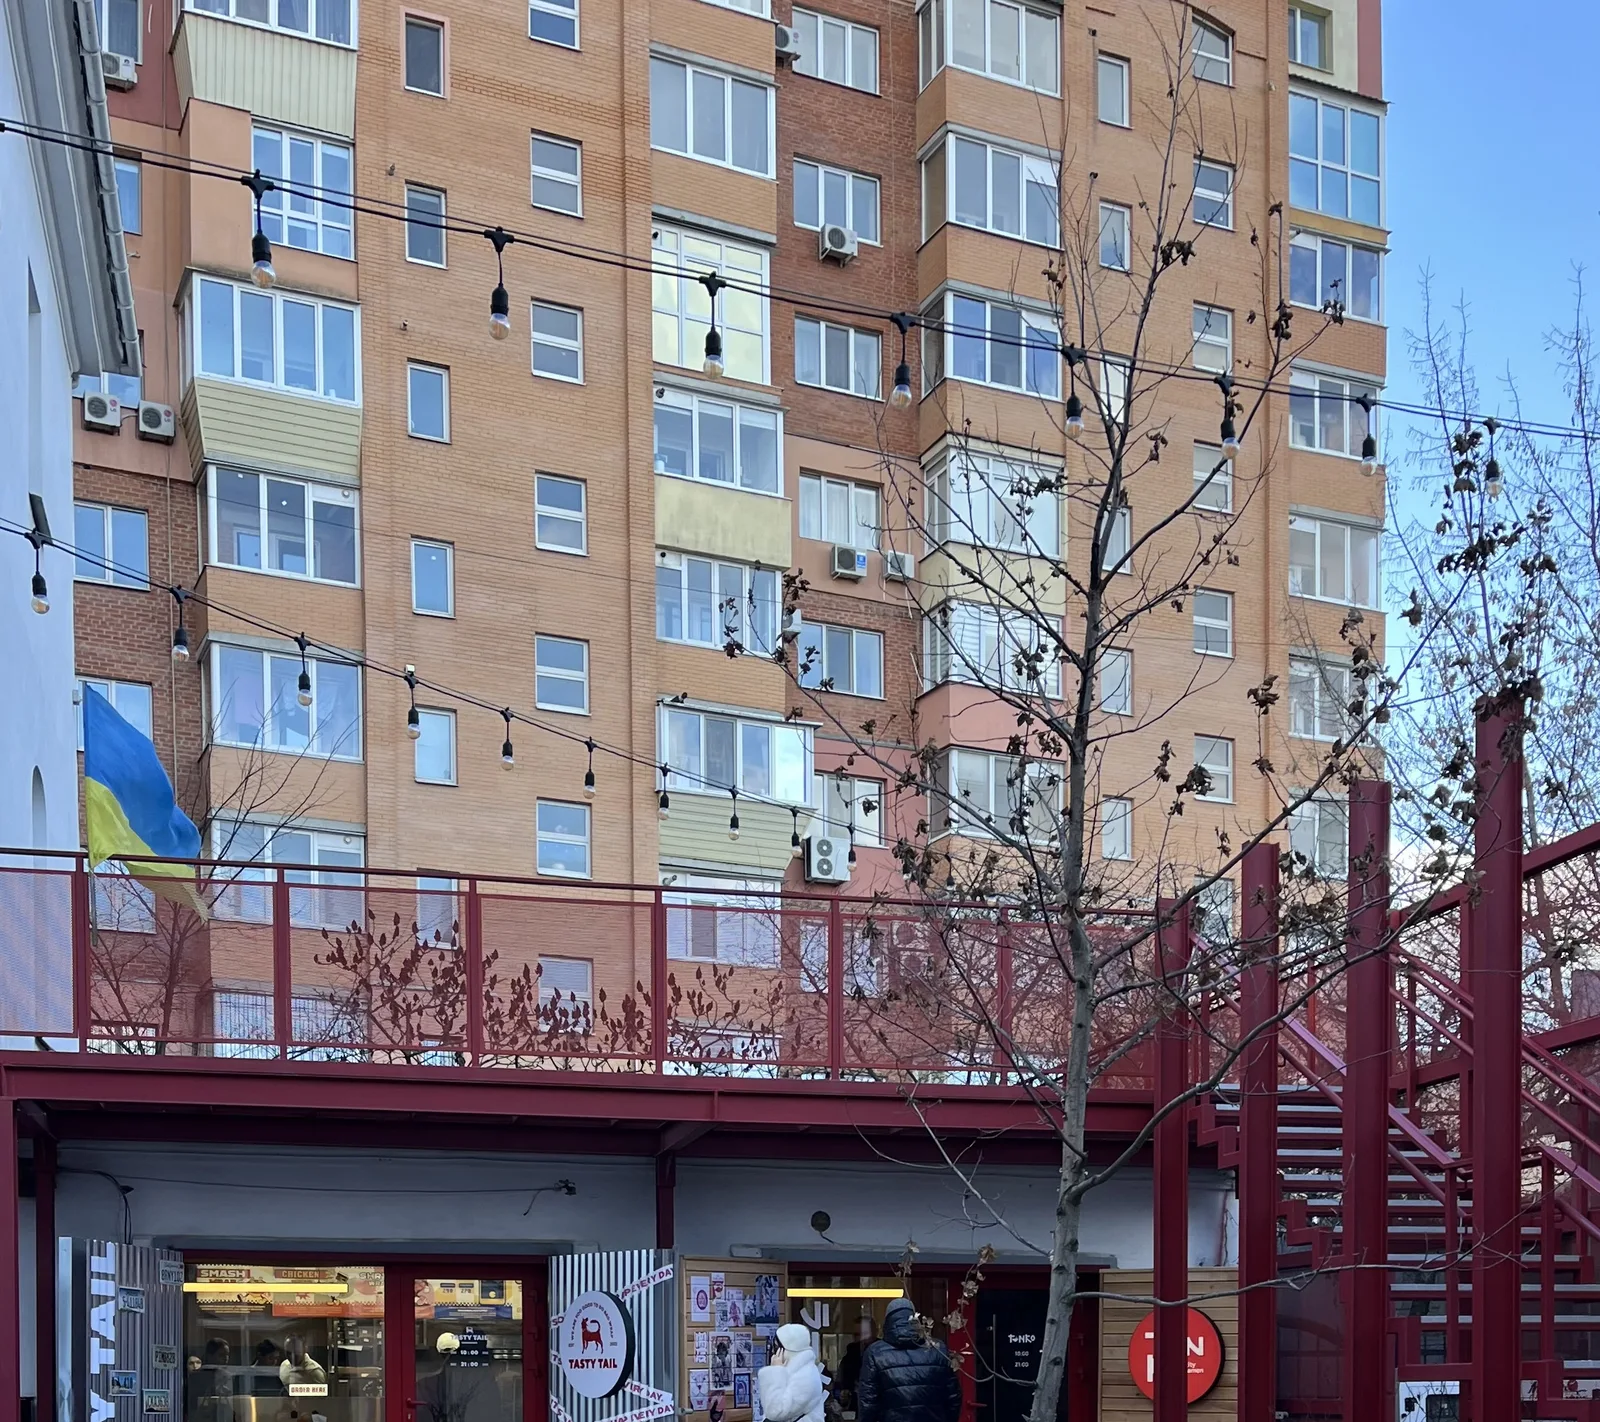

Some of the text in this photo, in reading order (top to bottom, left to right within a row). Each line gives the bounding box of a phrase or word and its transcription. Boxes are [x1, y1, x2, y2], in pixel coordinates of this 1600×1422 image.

[200, 1269, 246, 1278] SMASH
[281, 1270, 320, 1279] CHICKEN
[90, 1241, 116, 1375] TAIL
[473, 1333, 489, 1341] TAIL
[568, 1358, 618, 1369] TASTY TAIL
